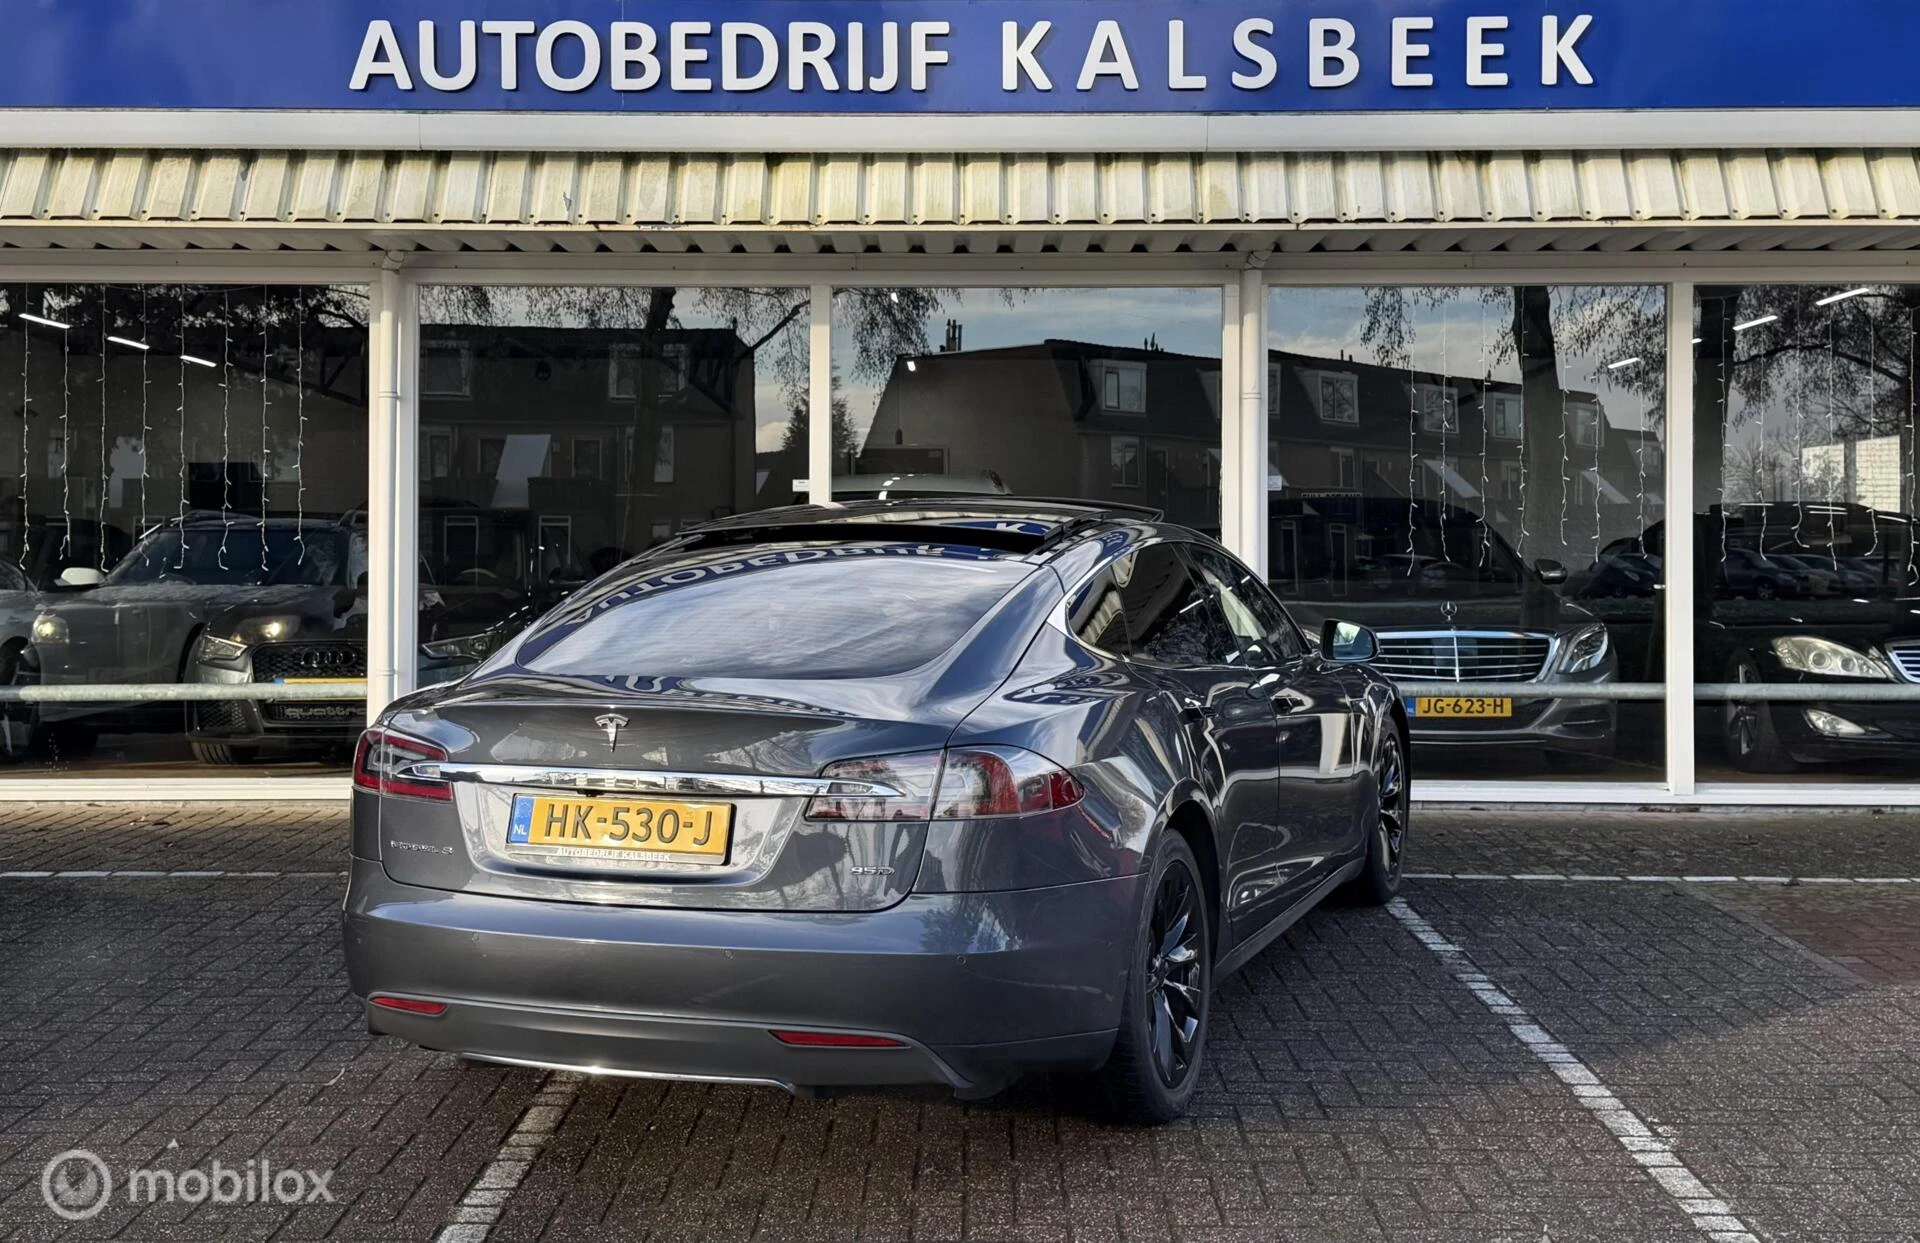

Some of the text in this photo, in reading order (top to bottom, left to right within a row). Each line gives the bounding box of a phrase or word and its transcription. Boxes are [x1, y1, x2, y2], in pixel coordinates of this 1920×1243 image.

[348, 14, 1594, 93] AUTOBEDRIJF KALSBEEK
[1422, 698, 1504, 714] JG-623-H
[513, 826, 527, 836] NL
[544, 803, 713, 846] HK-530-J
[556, 847, 671, 862] AUTOBEDRIJF KALSBEEK
